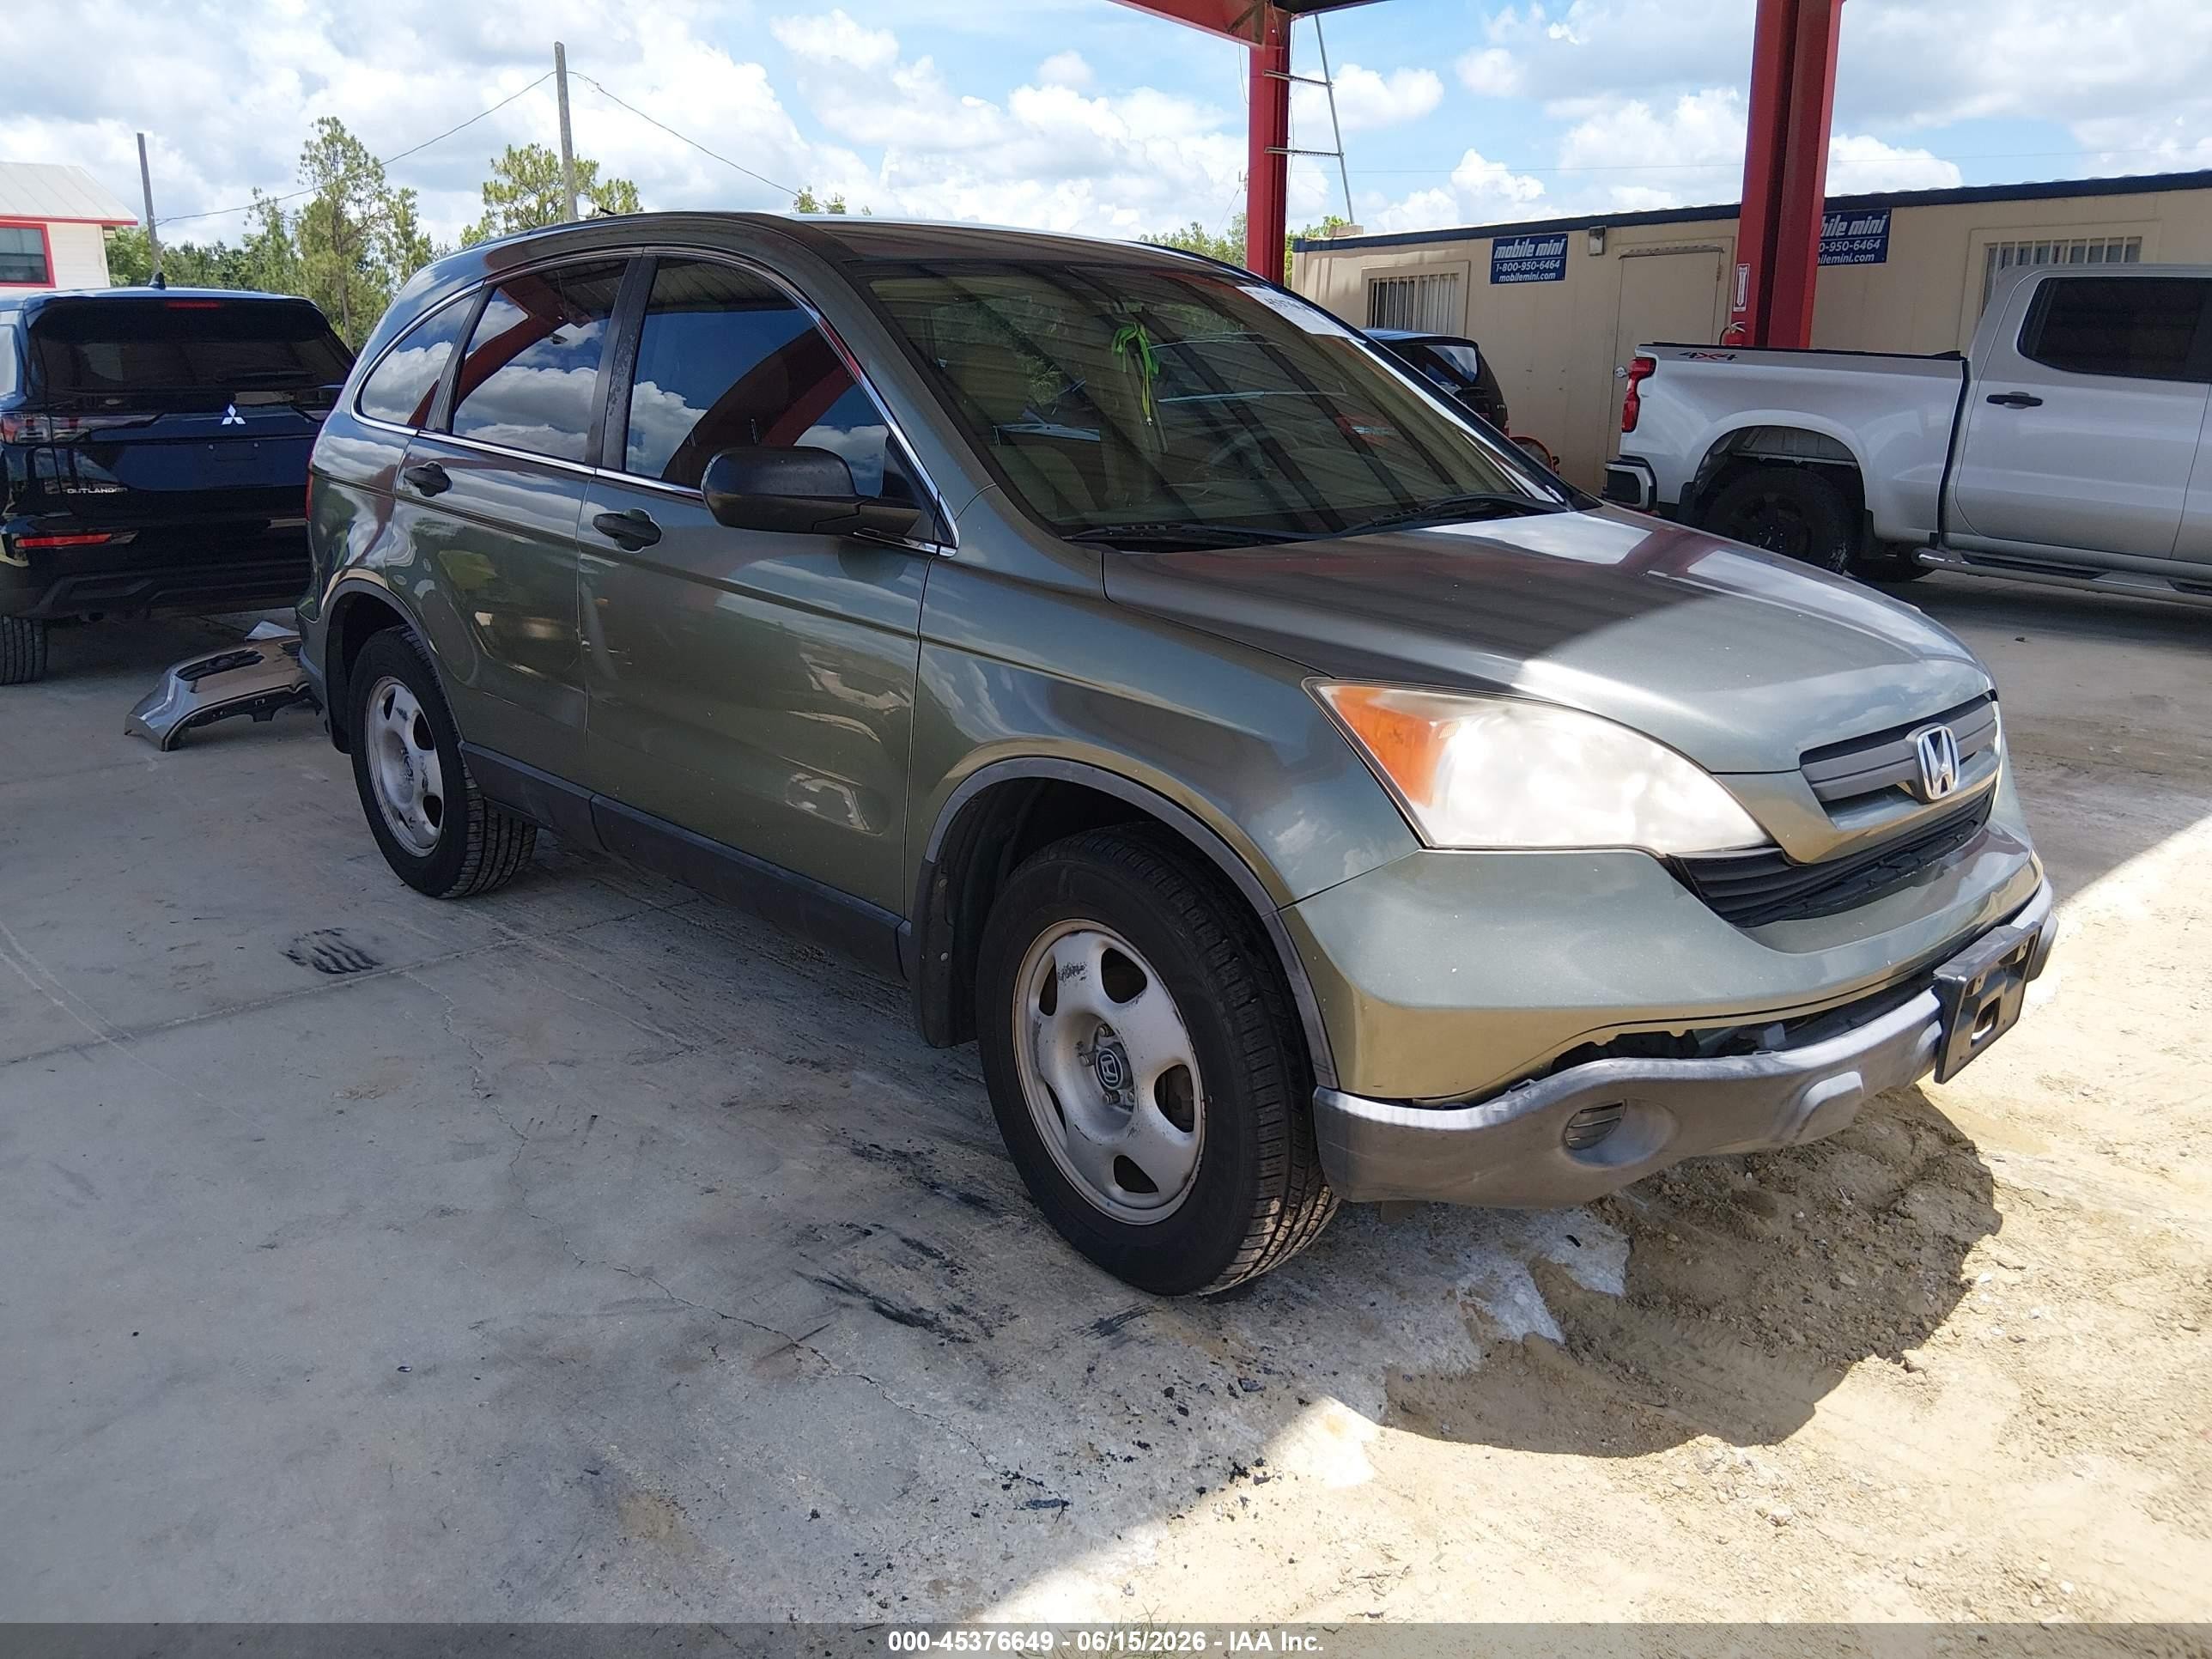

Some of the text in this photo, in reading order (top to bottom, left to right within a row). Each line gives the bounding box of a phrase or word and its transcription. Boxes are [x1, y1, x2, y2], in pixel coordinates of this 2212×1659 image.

[1820, 214, 1888, 237] bile mini
[1494, 239, 1567, 258] mobile mini
[1819, 239, 1881, 252] 0-950-6464
[1818, 252, 1875, 264] ilemini.com
[1496, 259, 1560, 272] 1-800-950-6464
[1498, 271, 1556, 283] mobilemini.com
